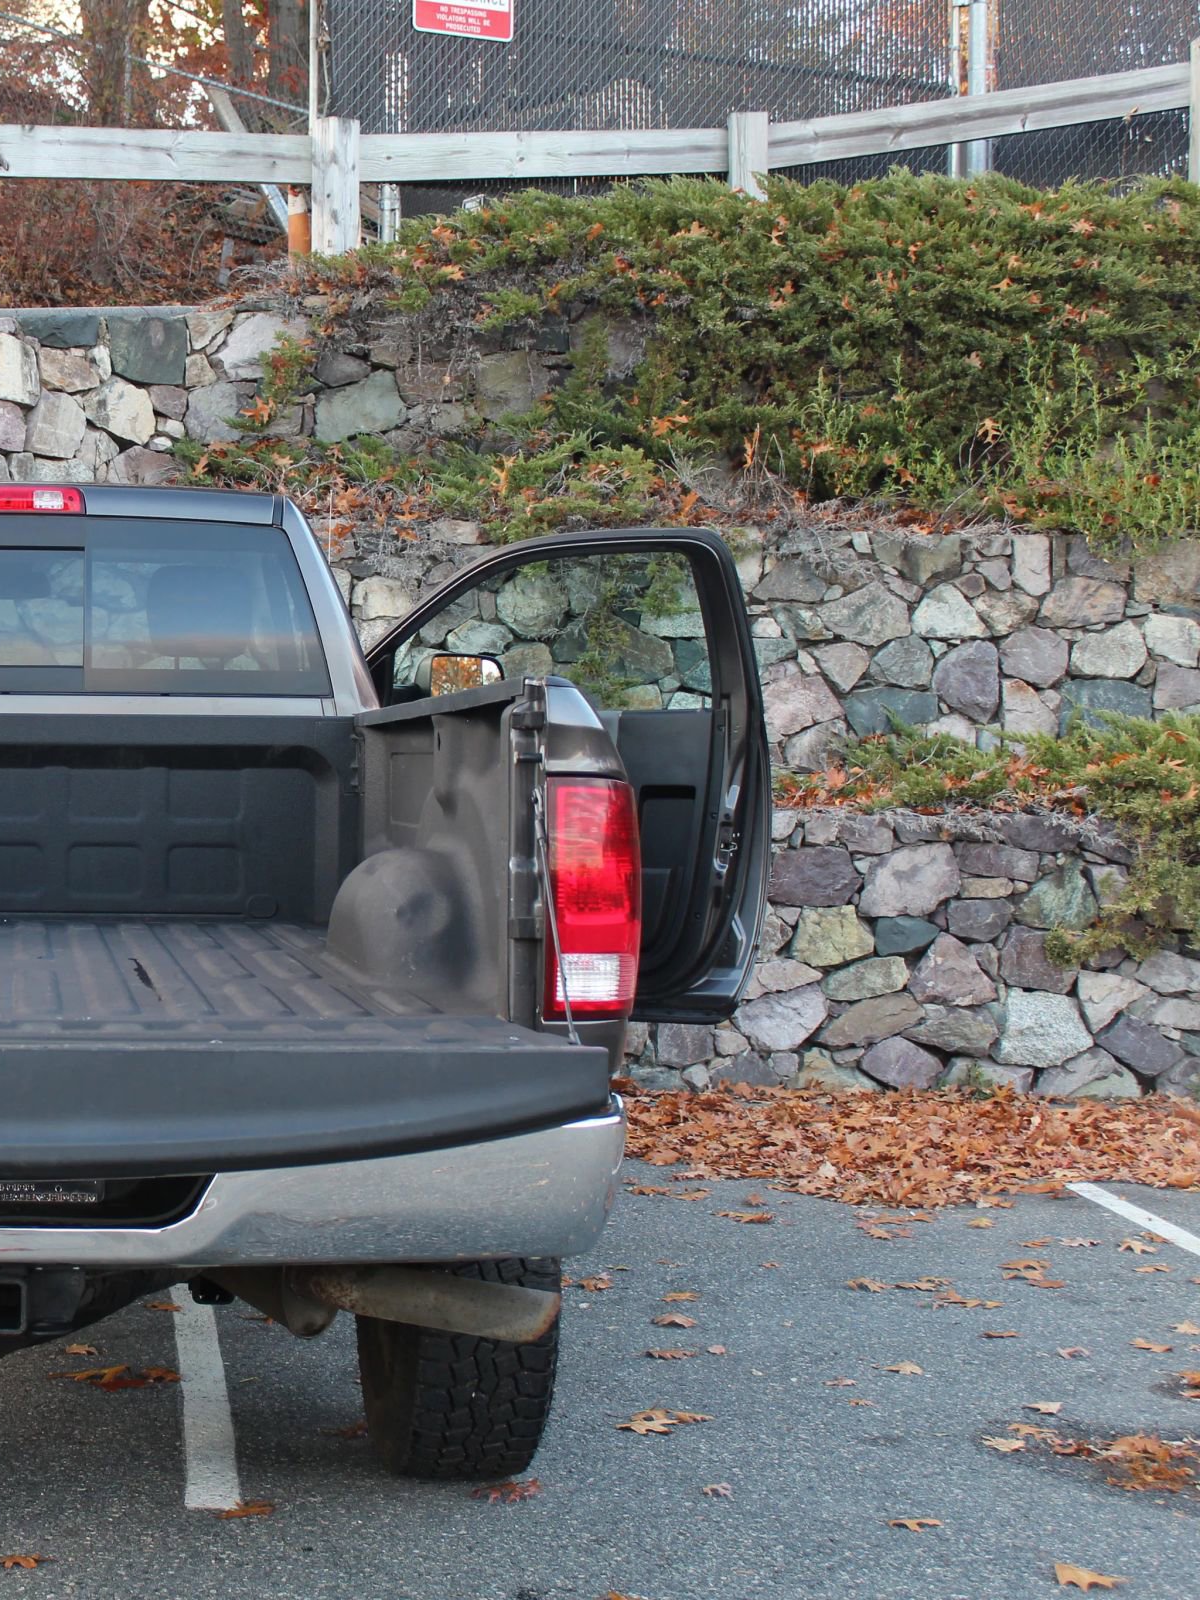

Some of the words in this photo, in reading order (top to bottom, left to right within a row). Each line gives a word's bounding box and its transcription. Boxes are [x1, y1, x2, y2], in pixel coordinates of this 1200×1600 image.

[440, 5, 448, 13] NO
[450, 6, 487, 18] TRESPASSING
[436, 12, 466, 23] VIOLATORS
[468, 17, 481, 25] WILL
[445, 22, 481, 33] PROSECUTED
